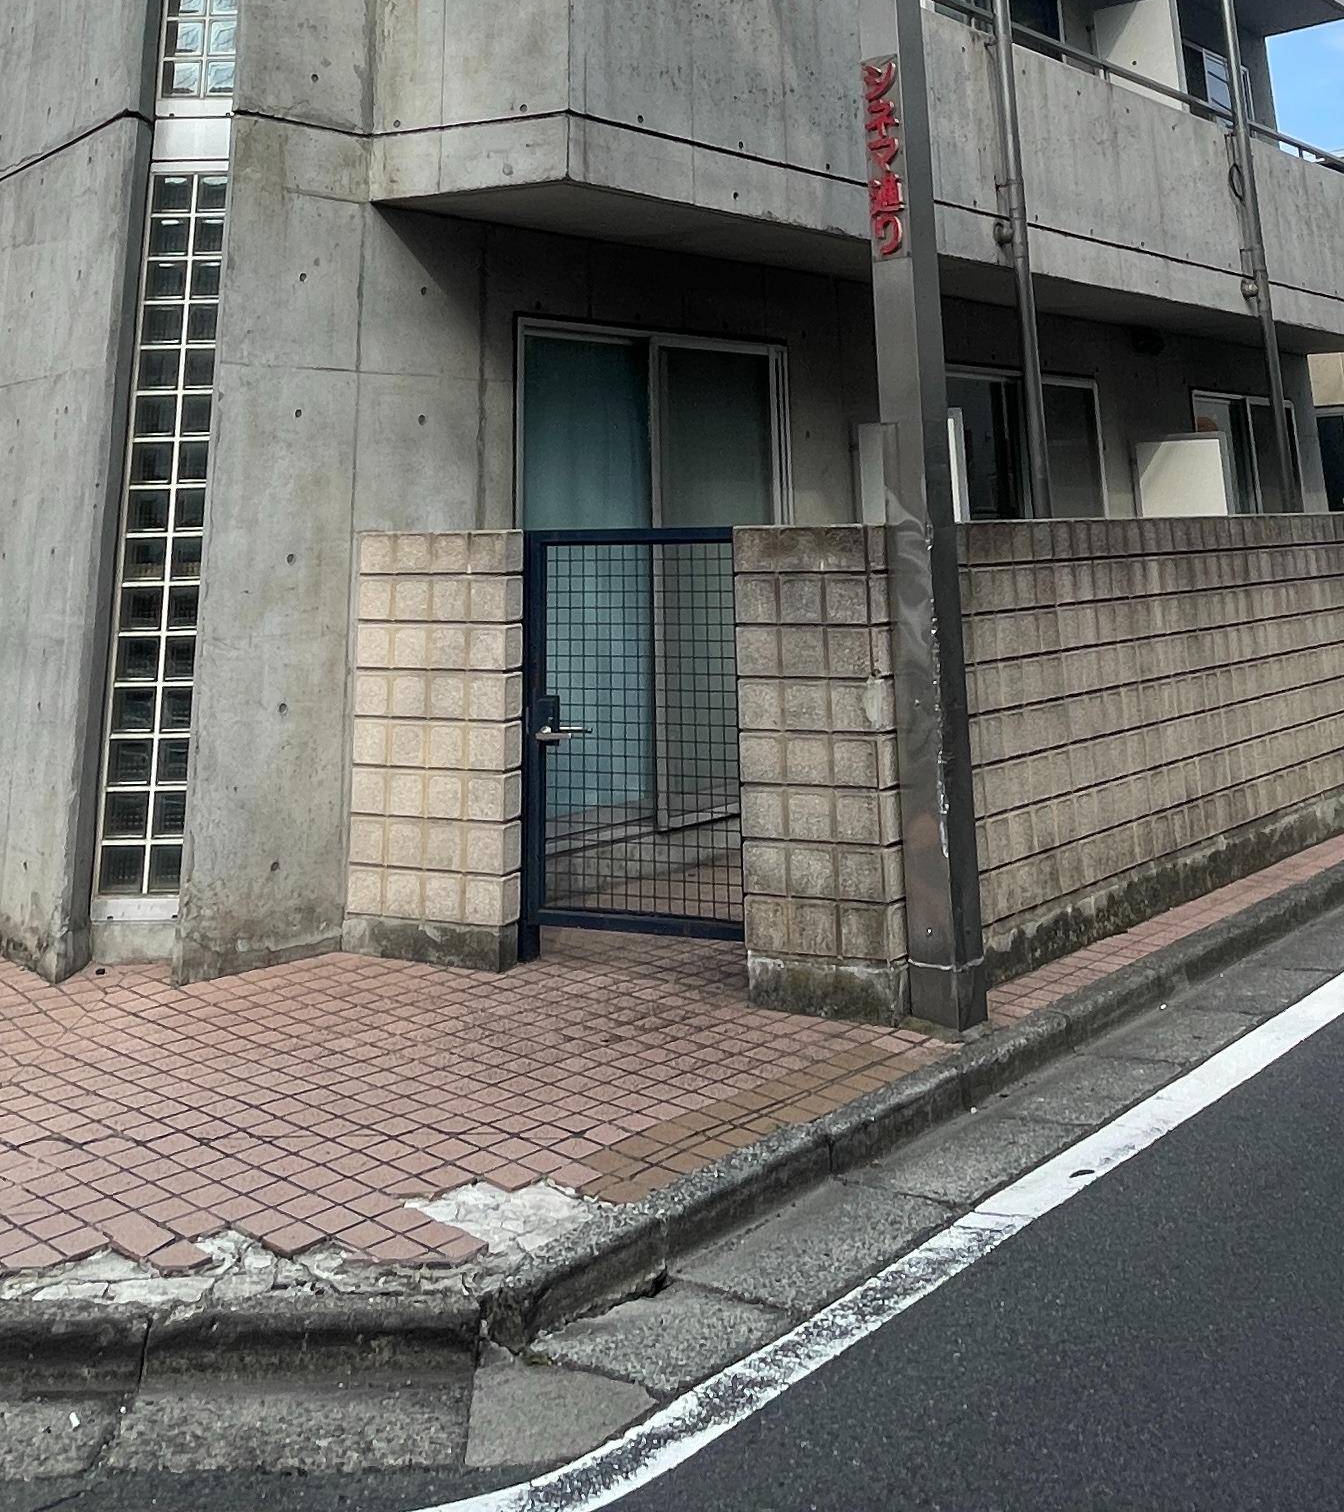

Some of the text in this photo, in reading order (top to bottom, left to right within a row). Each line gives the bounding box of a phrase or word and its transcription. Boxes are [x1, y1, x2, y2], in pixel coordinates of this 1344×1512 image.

[862, 62, 905, 255] シネマ通り
